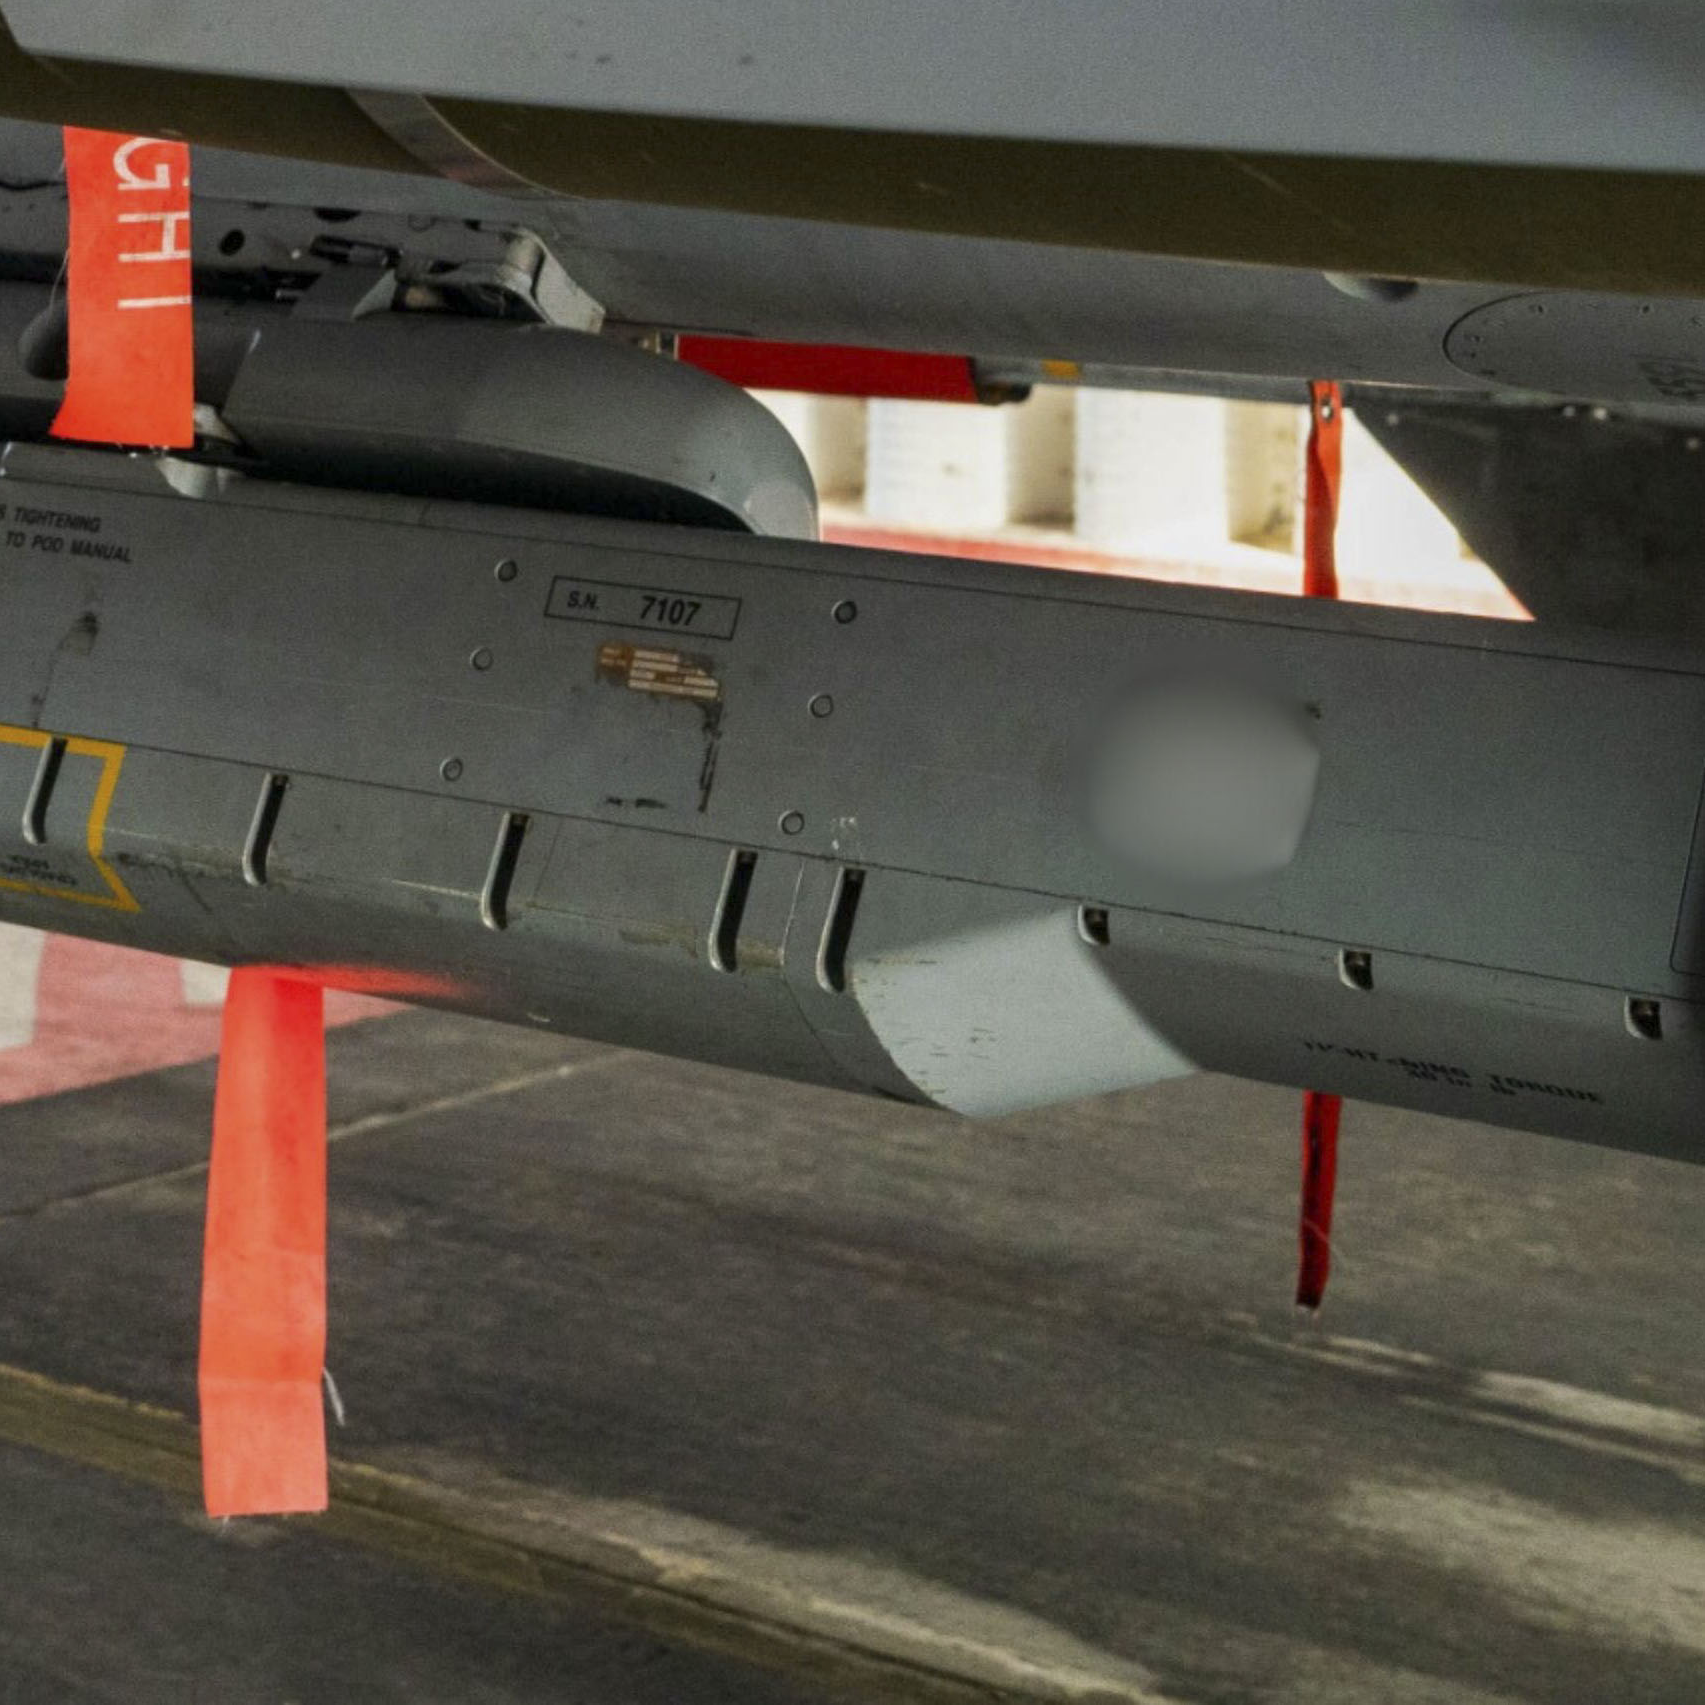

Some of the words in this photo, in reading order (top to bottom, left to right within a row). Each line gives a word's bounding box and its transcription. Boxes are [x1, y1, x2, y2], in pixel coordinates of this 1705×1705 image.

[14, 506, 103, 534] TIGHTENING
[5, 530, 26, 548] TO
[30, 534, 65, 553] POD
[69, 540, 135, 564] MANUAL
[566, 590, 601, 611] S.N.
[640, 595, 702, 626] 7107
